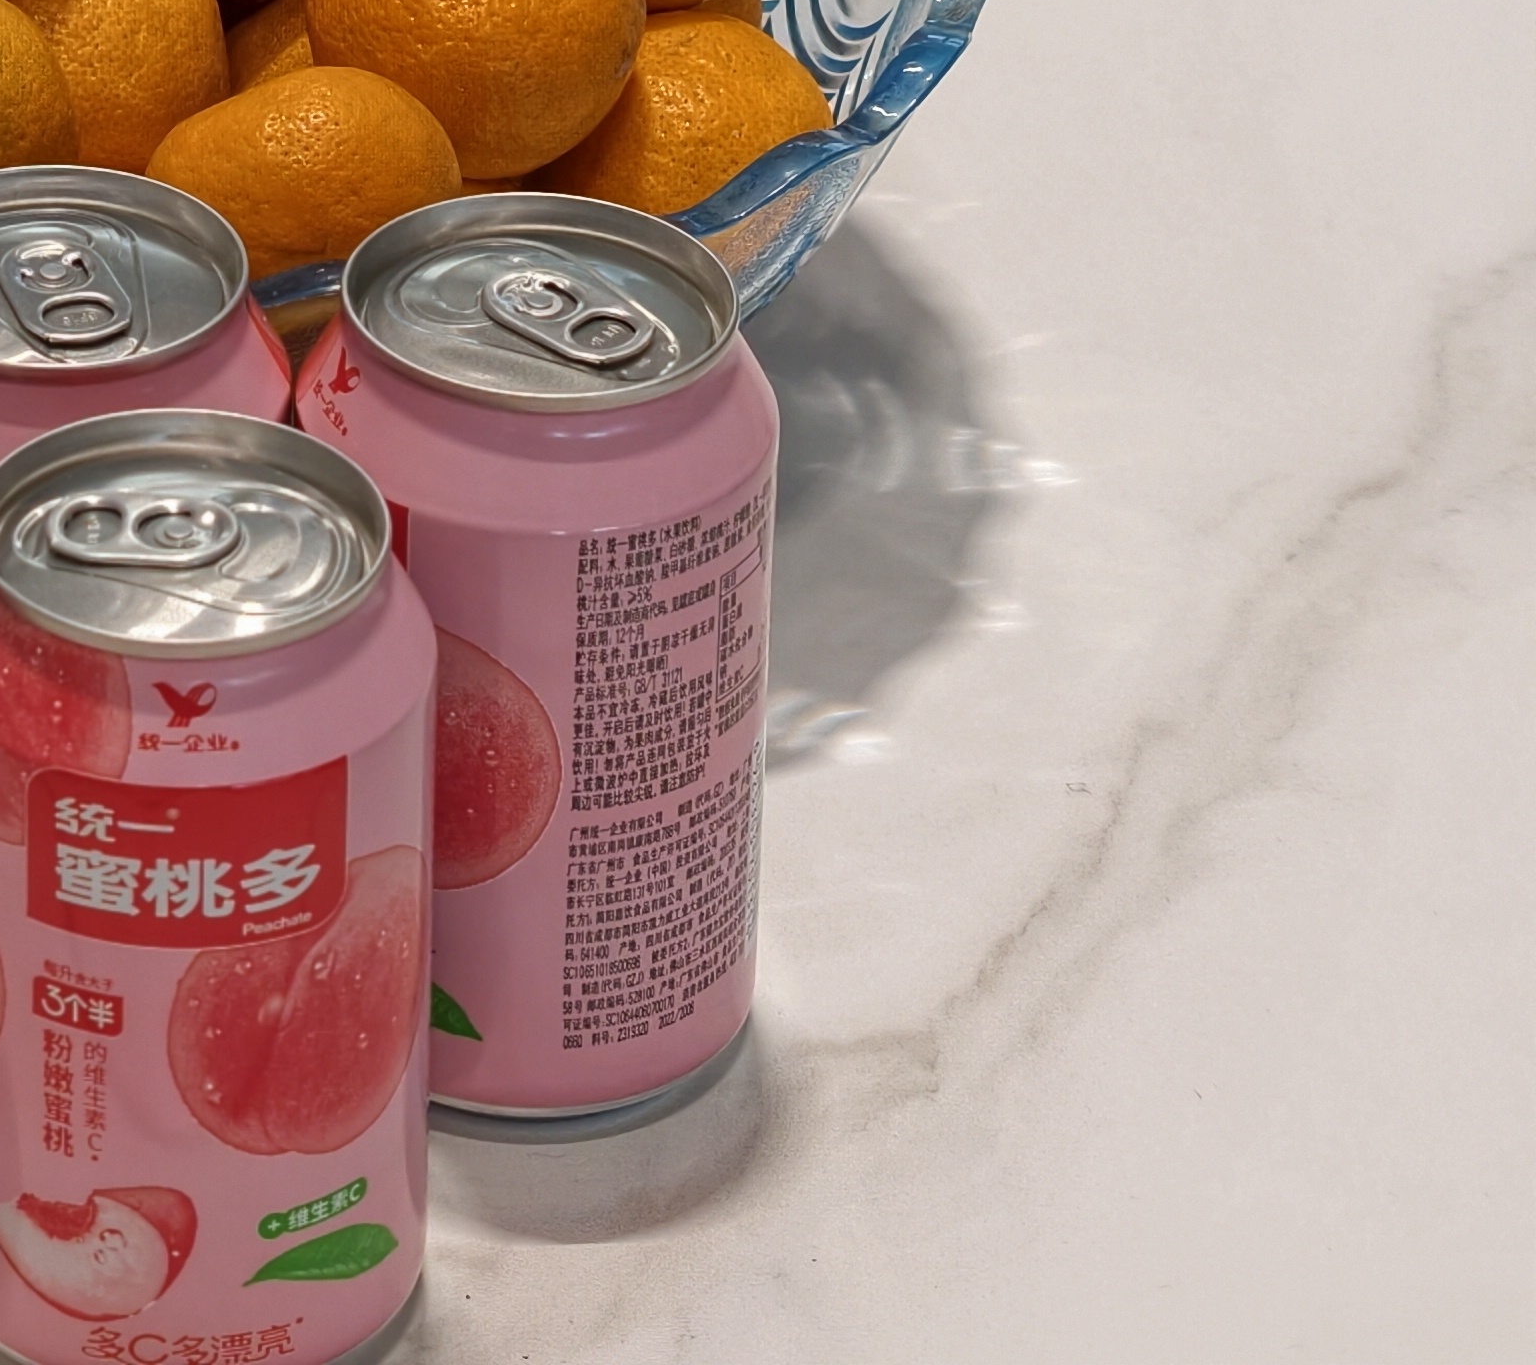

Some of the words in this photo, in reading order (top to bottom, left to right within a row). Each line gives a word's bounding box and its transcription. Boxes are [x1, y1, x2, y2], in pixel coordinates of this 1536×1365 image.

[54, 797, 176, 842] 统一
[54, 842, 321, 918] 蜜桃多
